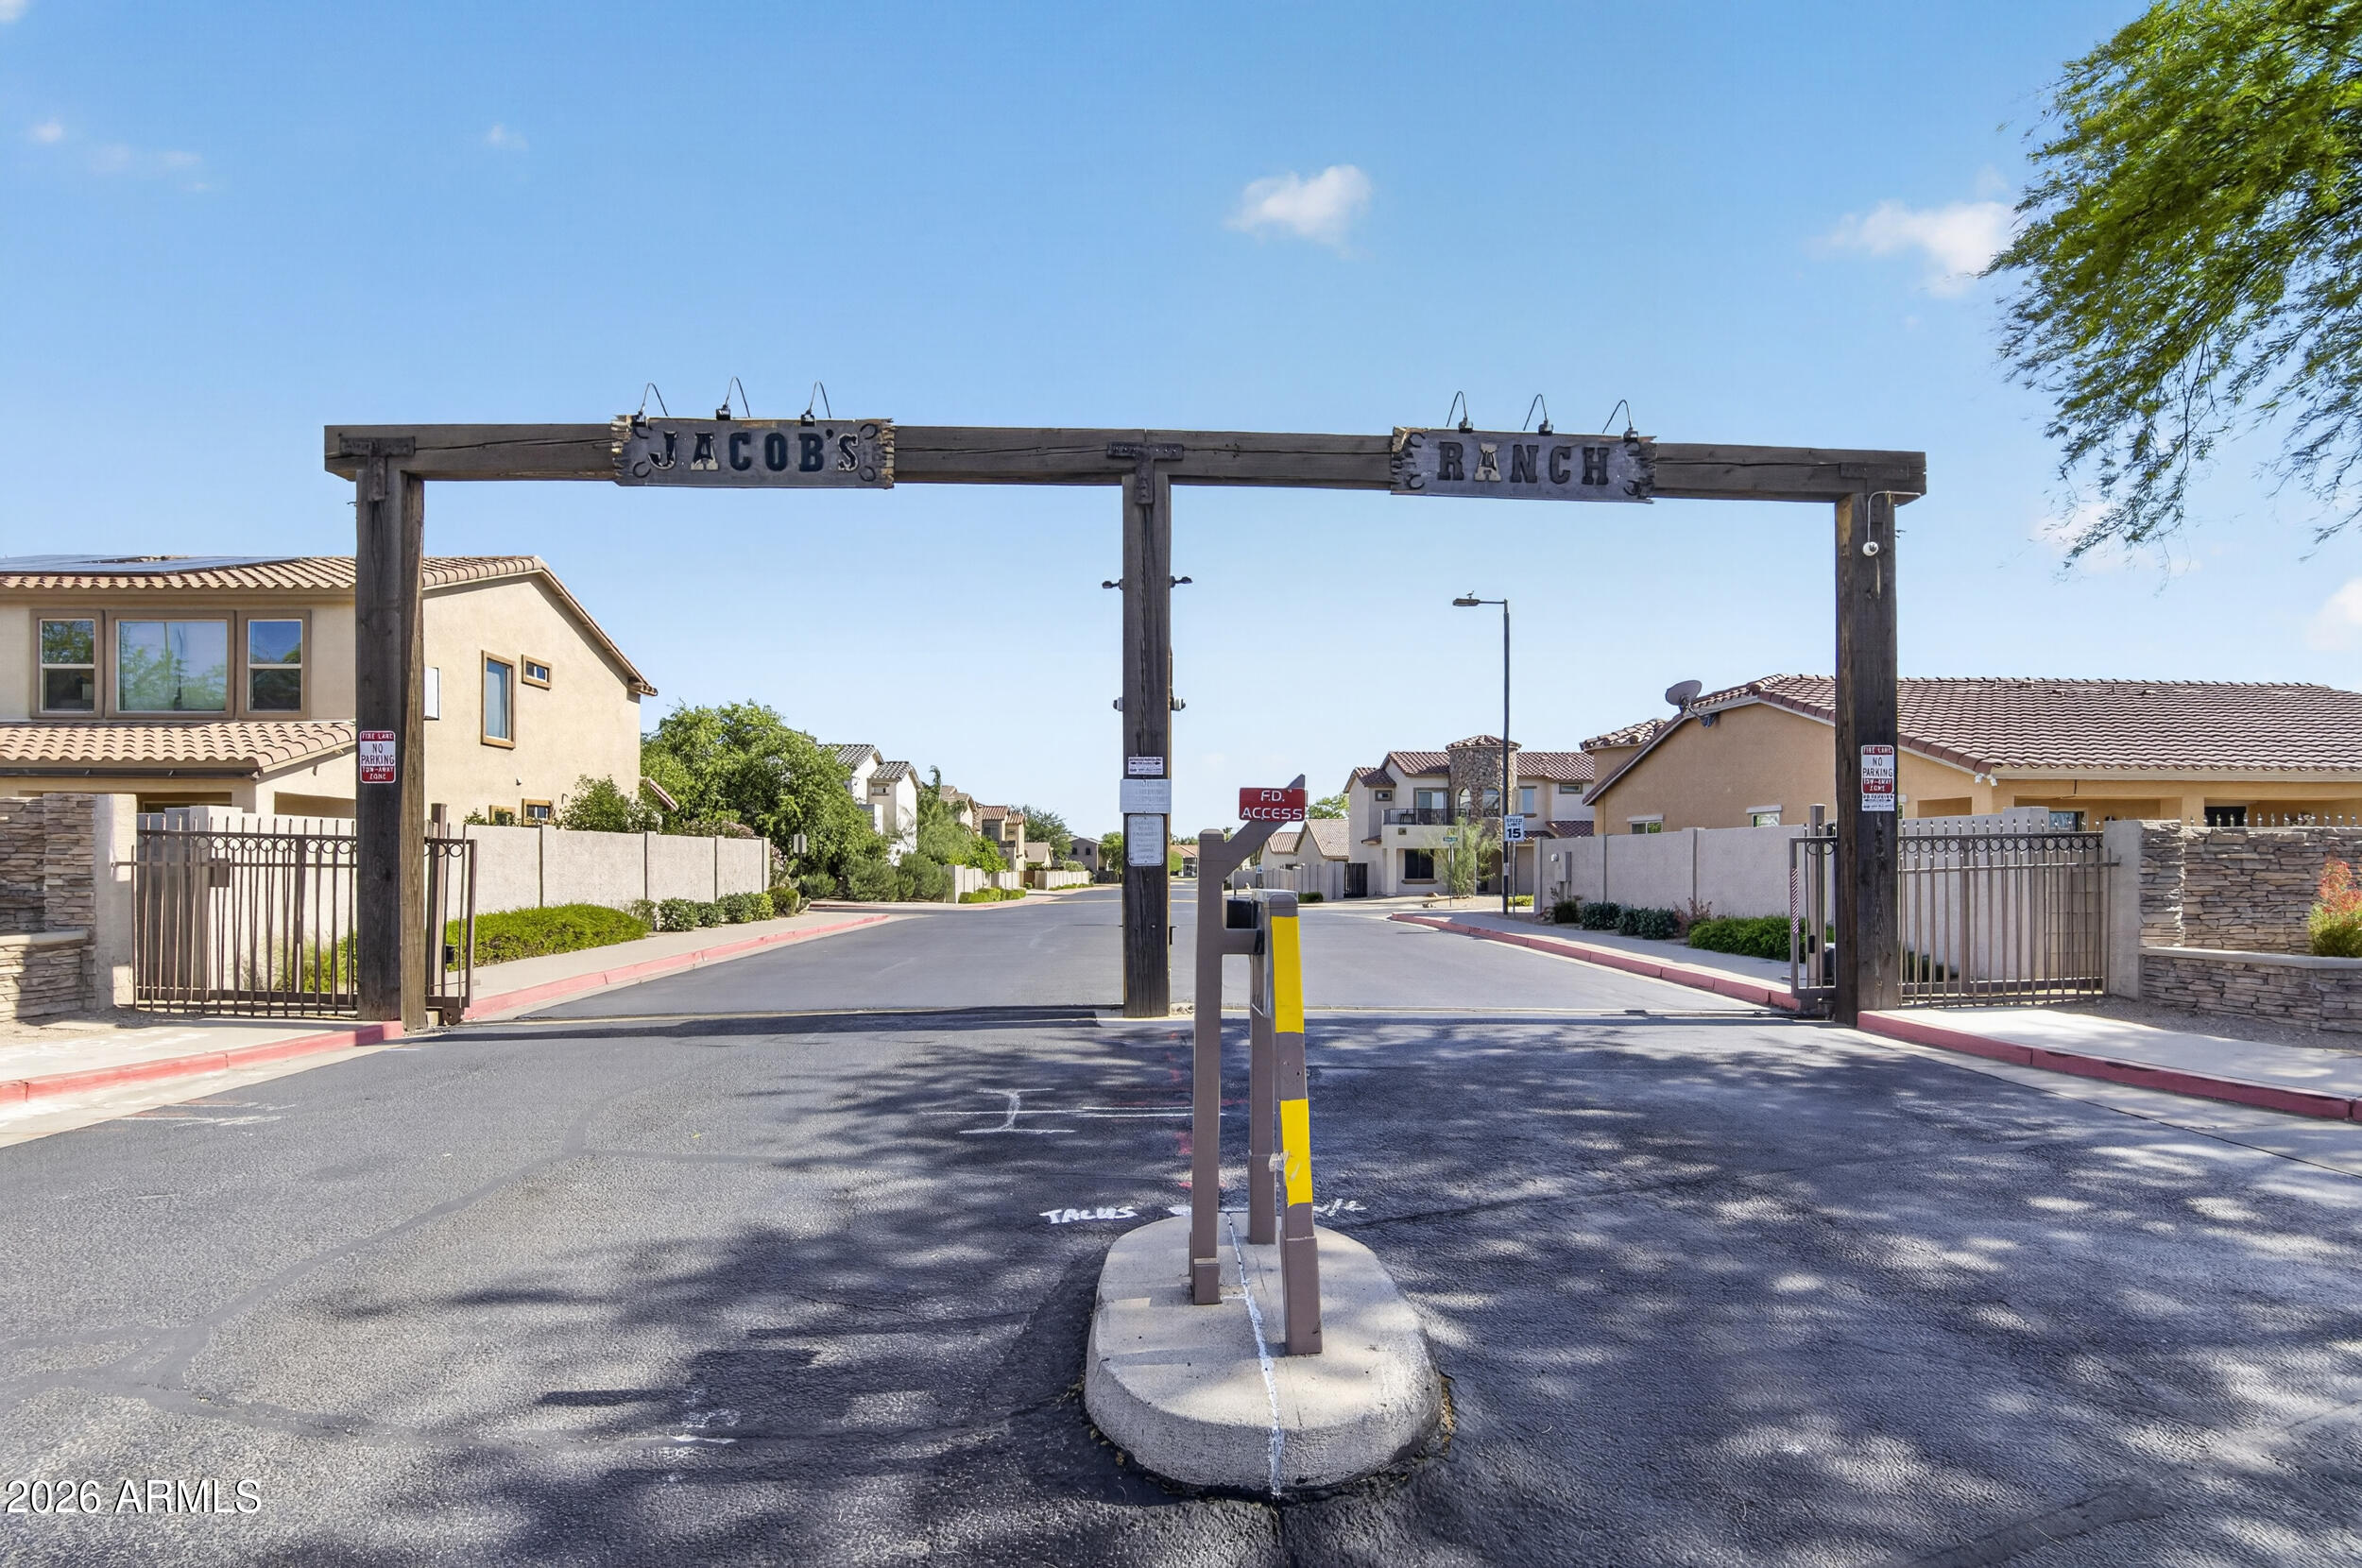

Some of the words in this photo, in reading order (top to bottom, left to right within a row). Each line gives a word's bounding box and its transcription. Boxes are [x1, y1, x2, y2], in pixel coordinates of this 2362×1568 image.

[648, 429, 859, 471] JACOB'S
[1437, 441, 1610, 485] RANCH
[372, 742, 384, 754] NO
[361, 755, 395, 765] PARKING
[1873, 757, 1883, 767] NO
[1862, 767, 1893, 777] PARKING
[1260, 790, 1285, 802] F.D.
[1241, 807, 1303, 820] ACCESS
[1507, 827, 1521, 839] 15
